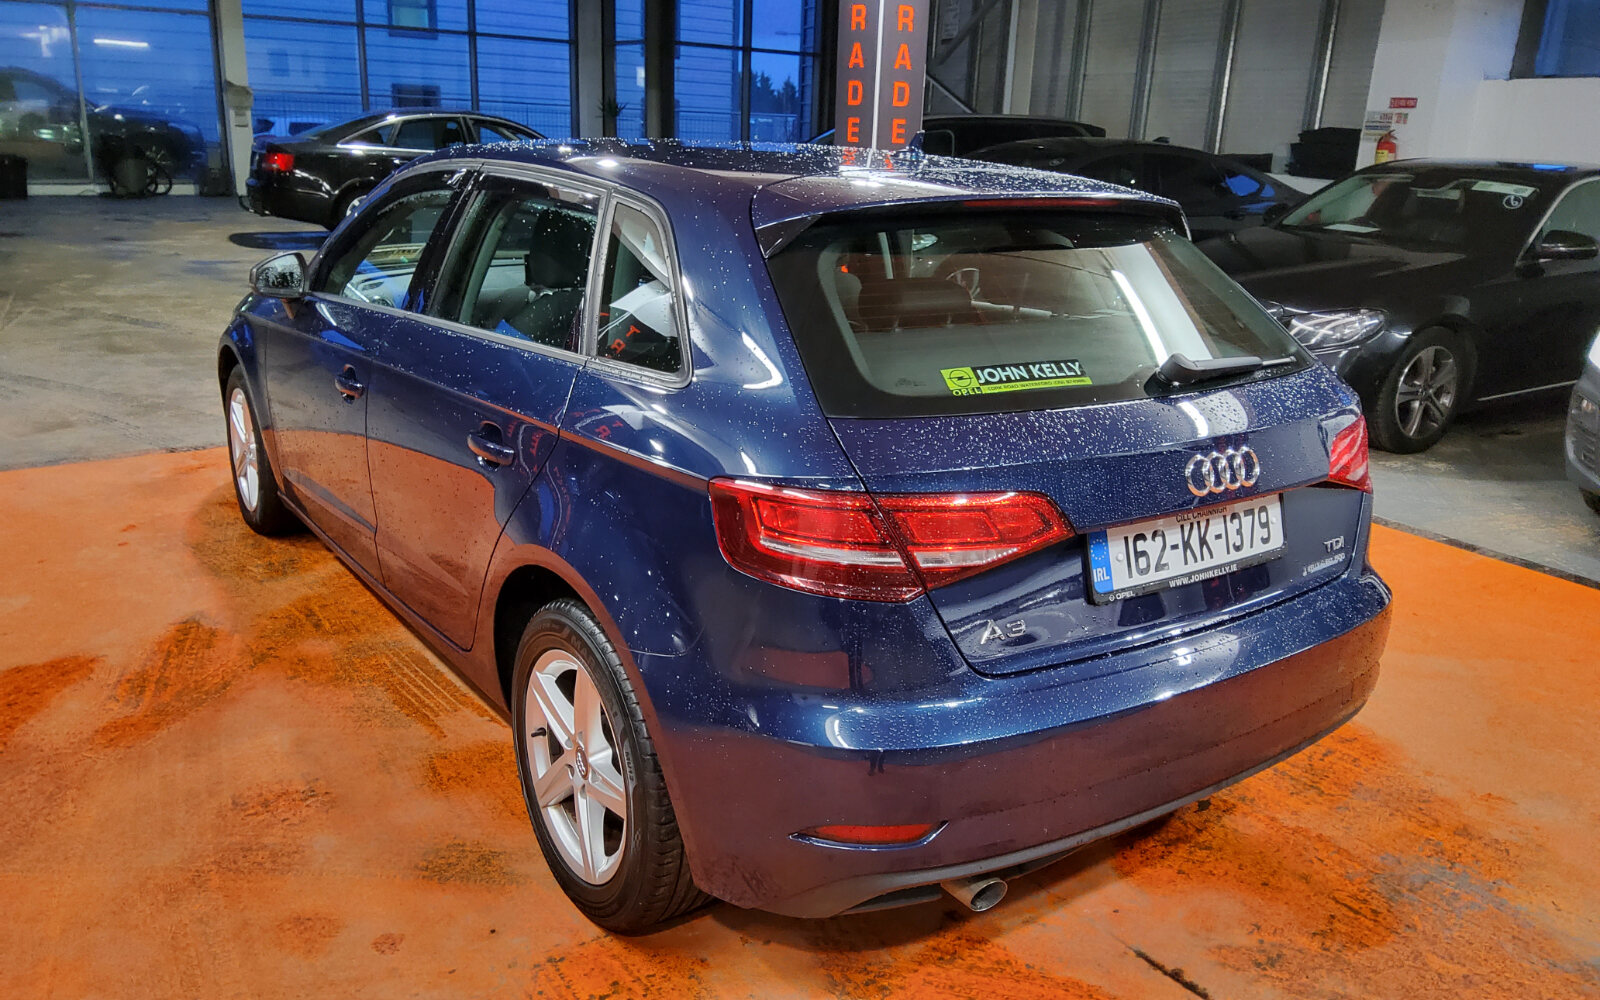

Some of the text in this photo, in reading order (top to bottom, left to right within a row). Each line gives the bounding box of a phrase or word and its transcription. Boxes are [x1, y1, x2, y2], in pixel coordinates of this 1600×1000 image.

[977, 362, 1081, 383] JOHN KELLY
[952, 387, 981, 396] OPEL
[1124, 506, 1271, 579] 162-KK-1379
[1323, 535, 1345, 552] TDI
[1093, 567, 1110, 583] IRL
[1169, 563, 1237, 588] WWW.JOHNKELLY.IE
[1115, 590, 1135, 600] OPEL
[981, 619, 1026, 645] A3
